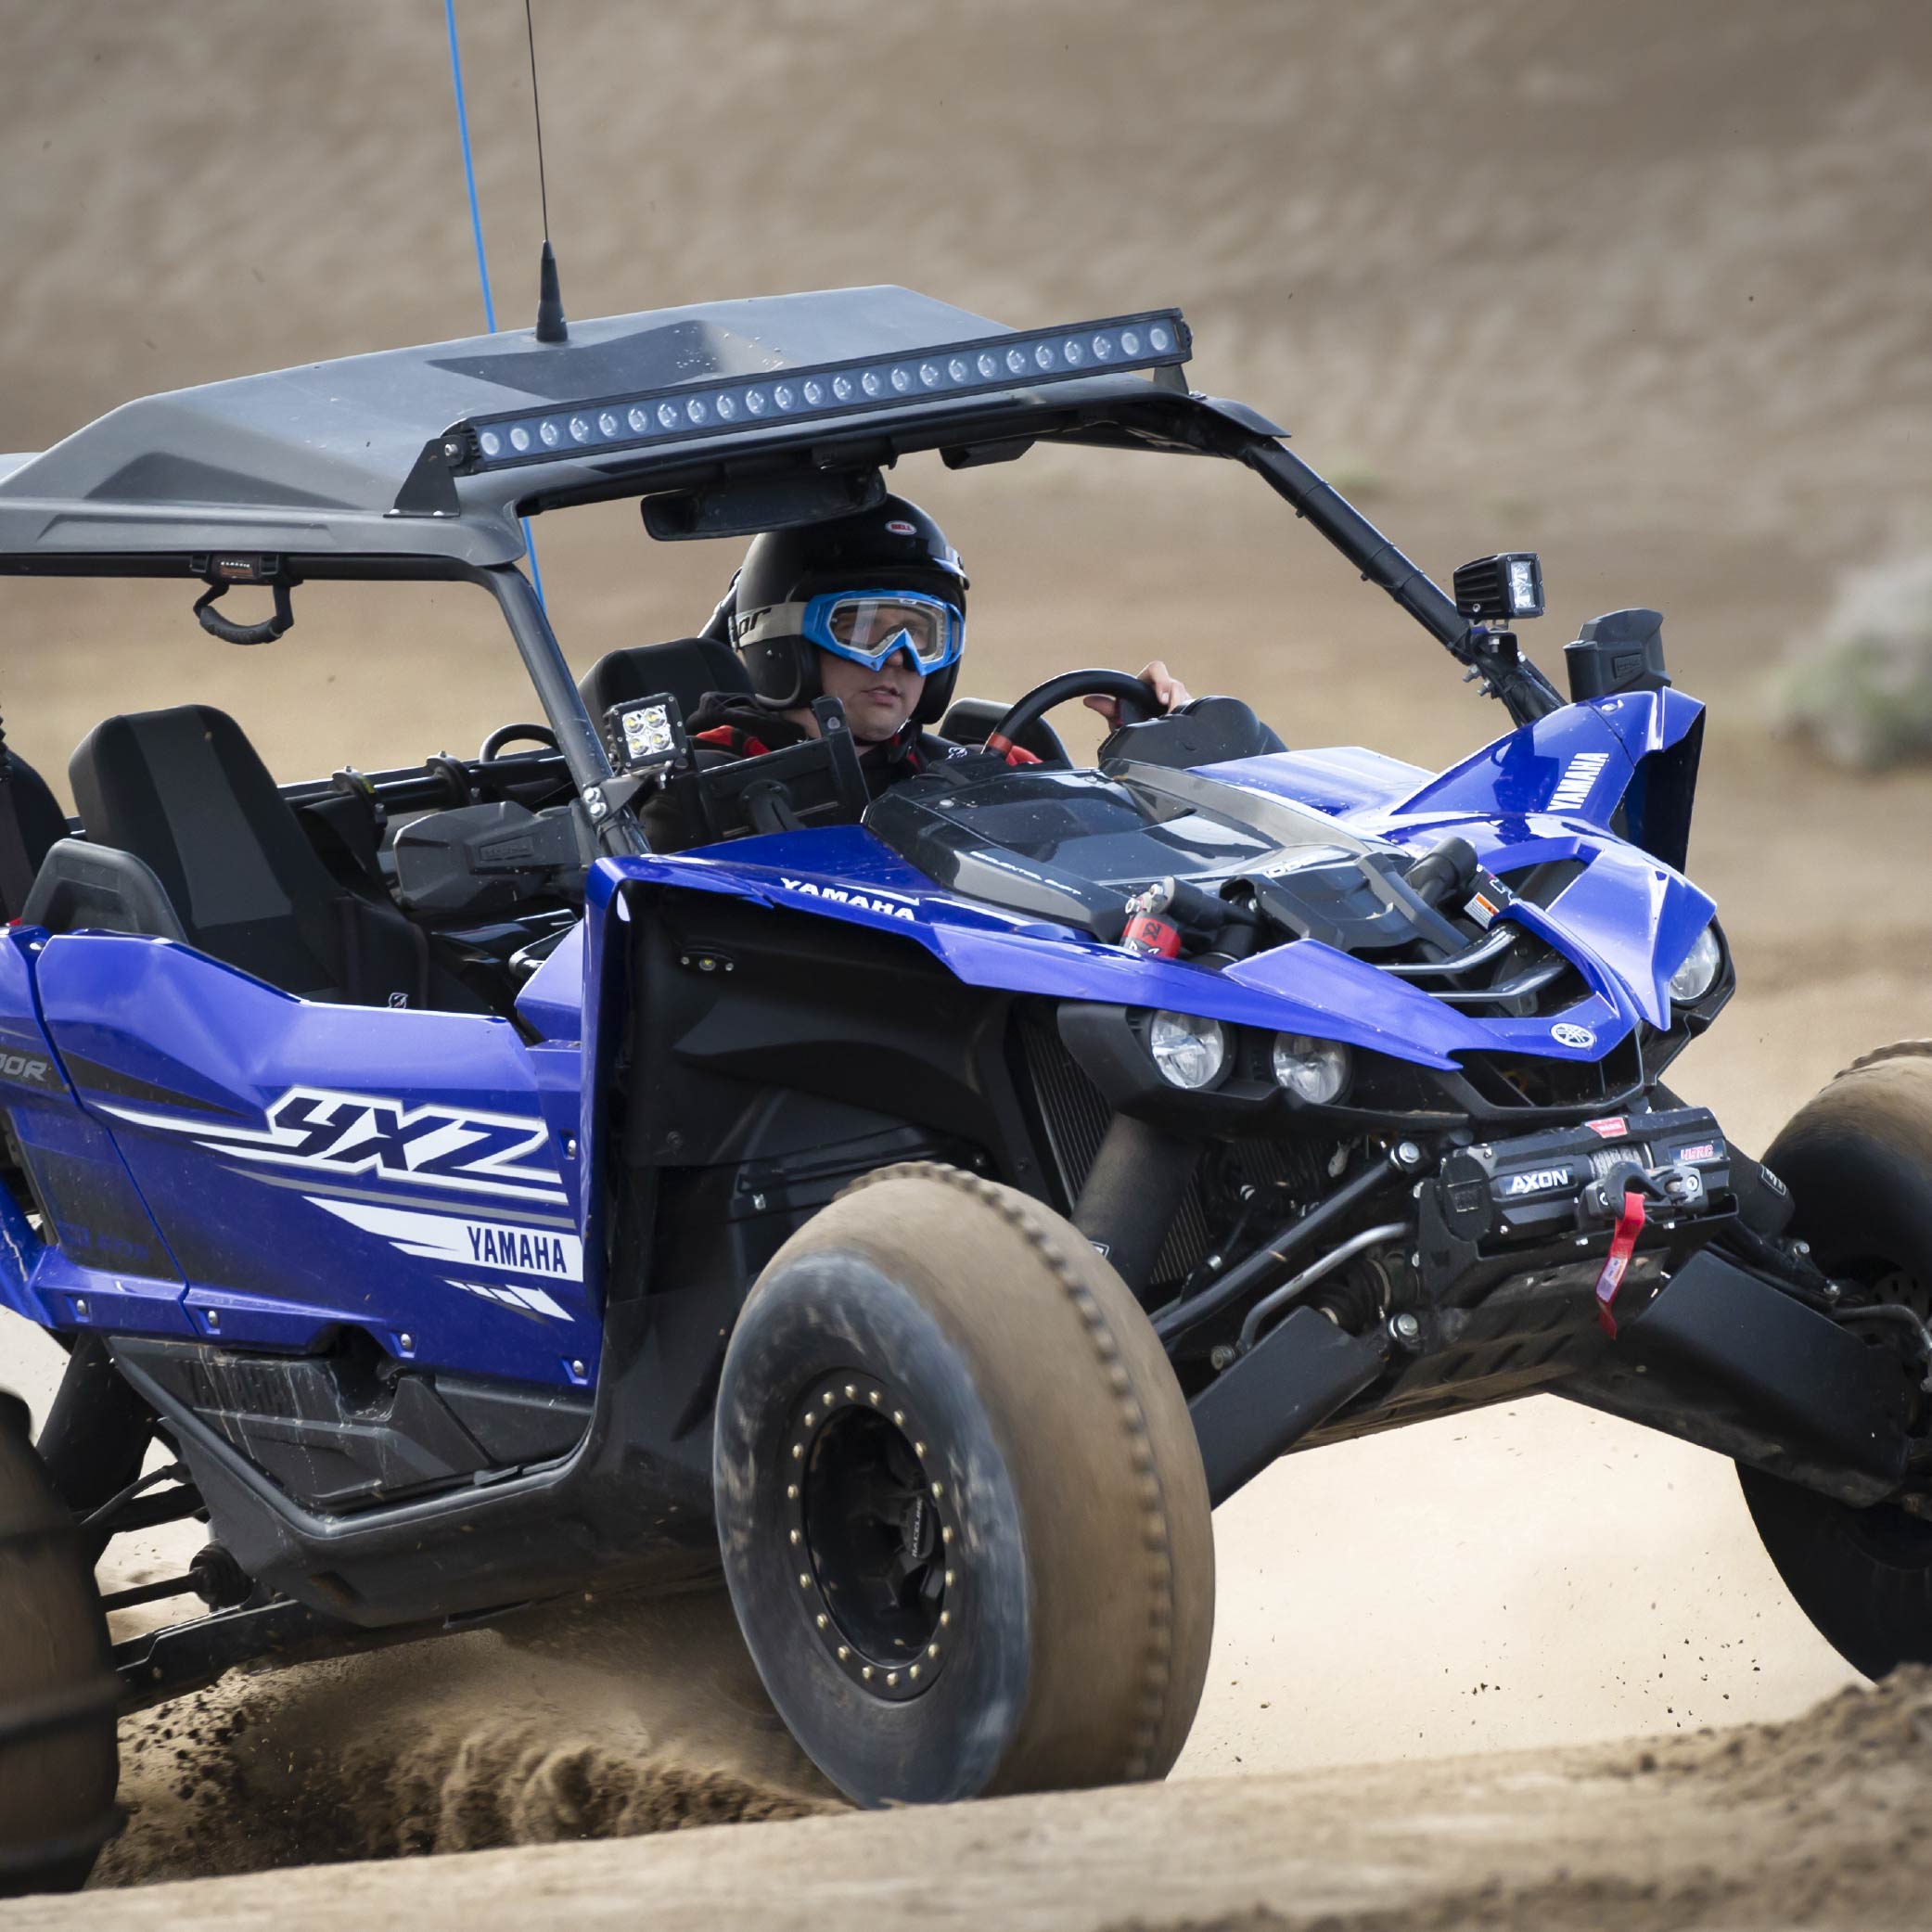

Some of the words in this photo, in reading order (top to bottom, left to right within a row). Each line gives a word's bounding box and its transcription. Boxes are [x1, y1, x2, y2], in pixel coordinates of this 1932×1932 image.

[1546, 752, 1609, 812] YAMAHA
[780, 877, 915, 922] YAMAHA
[269, 1088, 553, 1180] YXZ
[1509, 1169, 1569, 1194] AXON
[467, 1225, 569, 1274] YAMAHA
